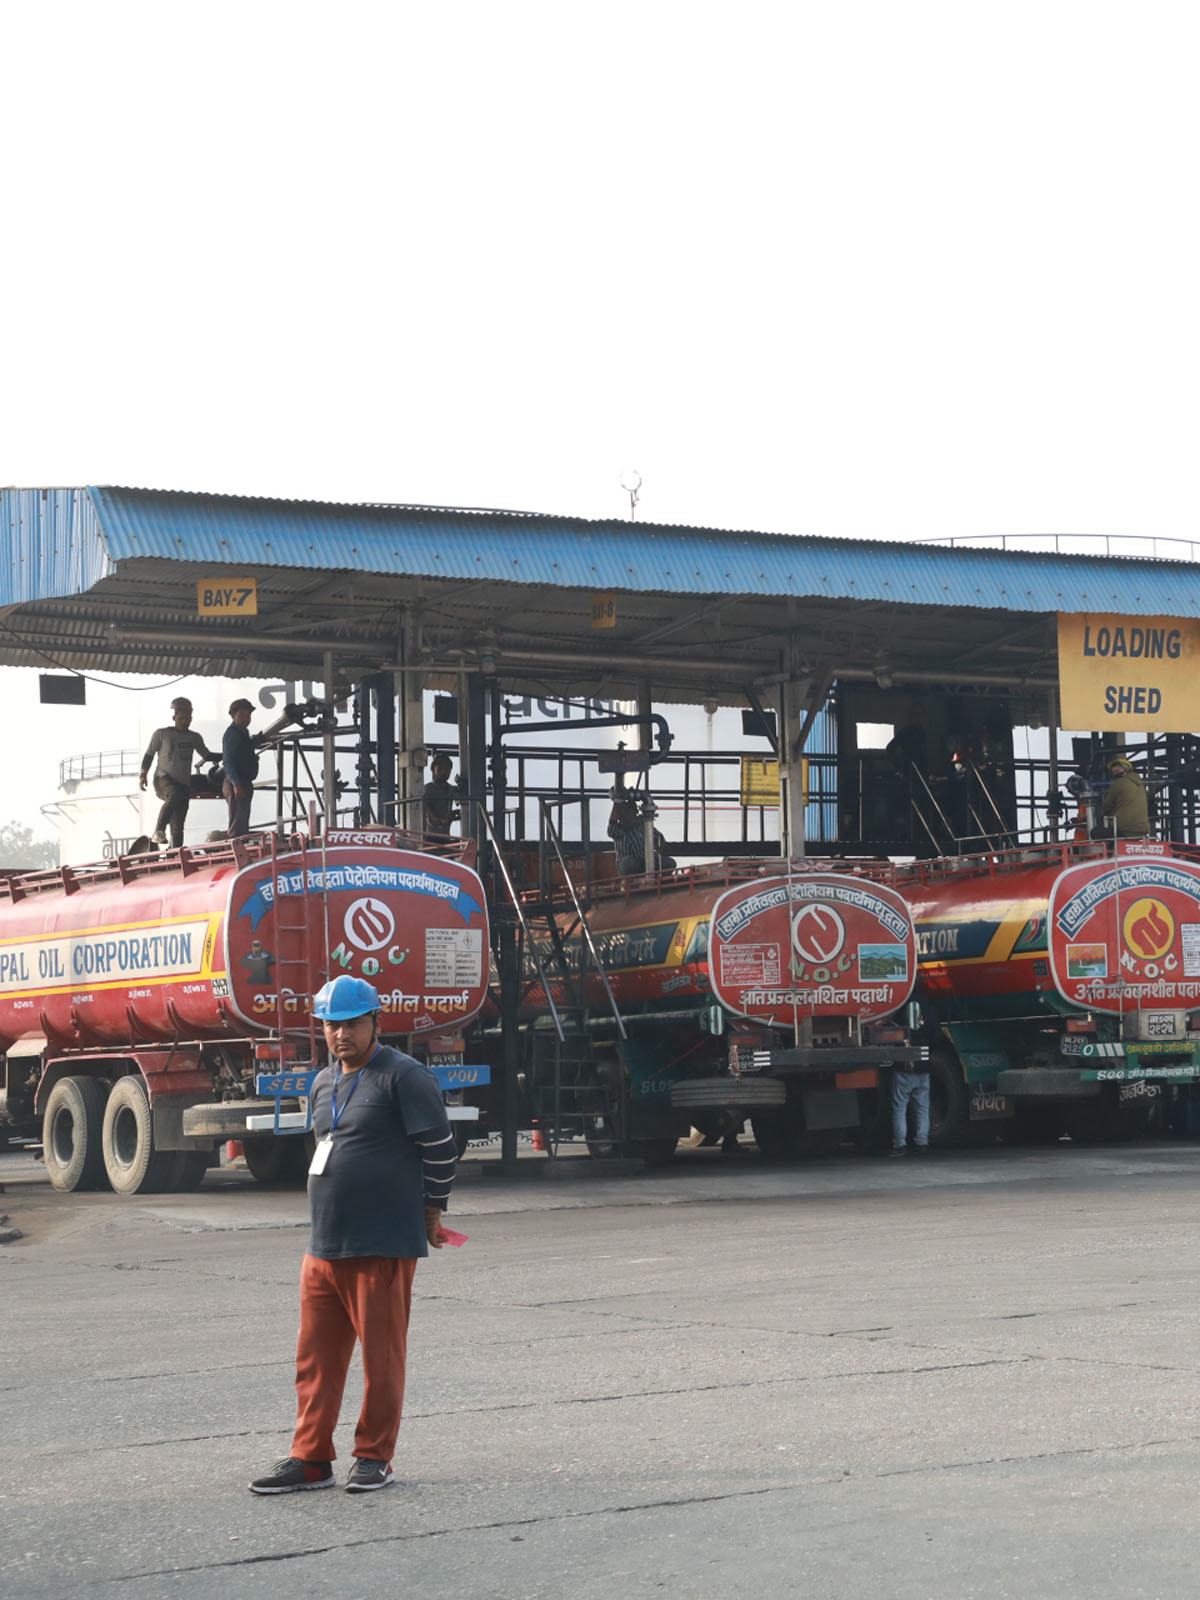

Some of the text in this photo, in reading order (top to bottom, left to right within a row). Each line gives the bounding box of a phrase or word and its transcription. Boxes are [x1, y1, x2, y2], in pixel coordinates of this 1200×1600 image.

[203, 588, 253, 606] BAY-7
[1083, 626, 1181, 658] LOADING
[1104, 686, 1161, 714] SHED
[38, 948, 65, 979] OIL
[72, 932, 192, 976] CORPORATION
[423, 989, 470, 1014] पदार्थ
[266, 1077, 308, 1092] SEE
[447, 1069, 478, 1083] YOU
